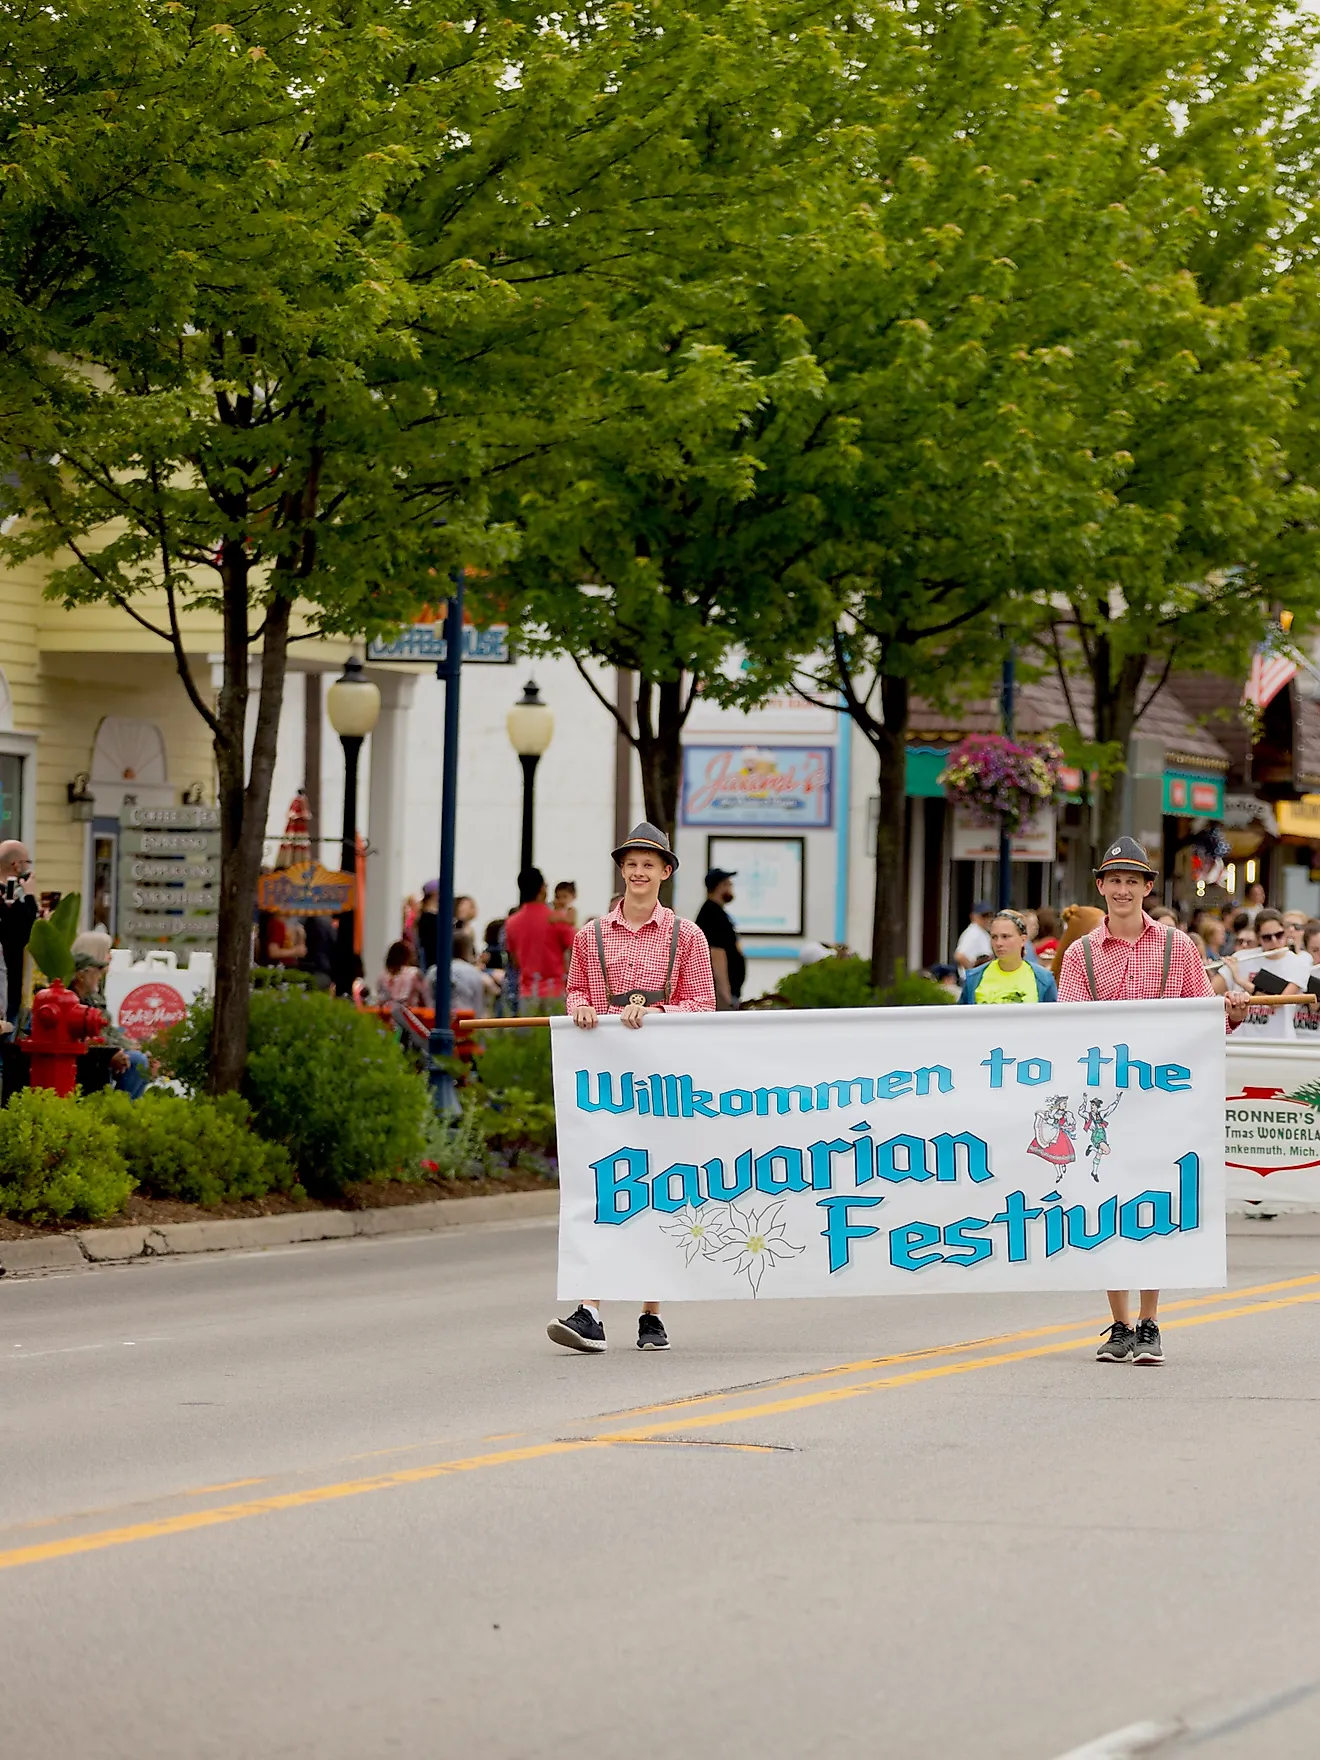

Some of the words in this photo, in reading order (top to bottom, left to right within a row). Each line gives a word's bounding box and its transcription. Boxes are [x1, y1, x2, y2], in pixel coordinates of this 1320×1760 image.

[575, 1064, 955, 1118] Willkommen
[980, 1047, 1052, 1089] to
[1077, 1043, 1193, 1092] the
[1225, 1109, 1315, 1125] RONNER'S
[588, 1121, 995, 1225] Bavarian
[1289, 1146, 1319, 1157] Mich.
[816, 1151, 1200, 1275] Festival
